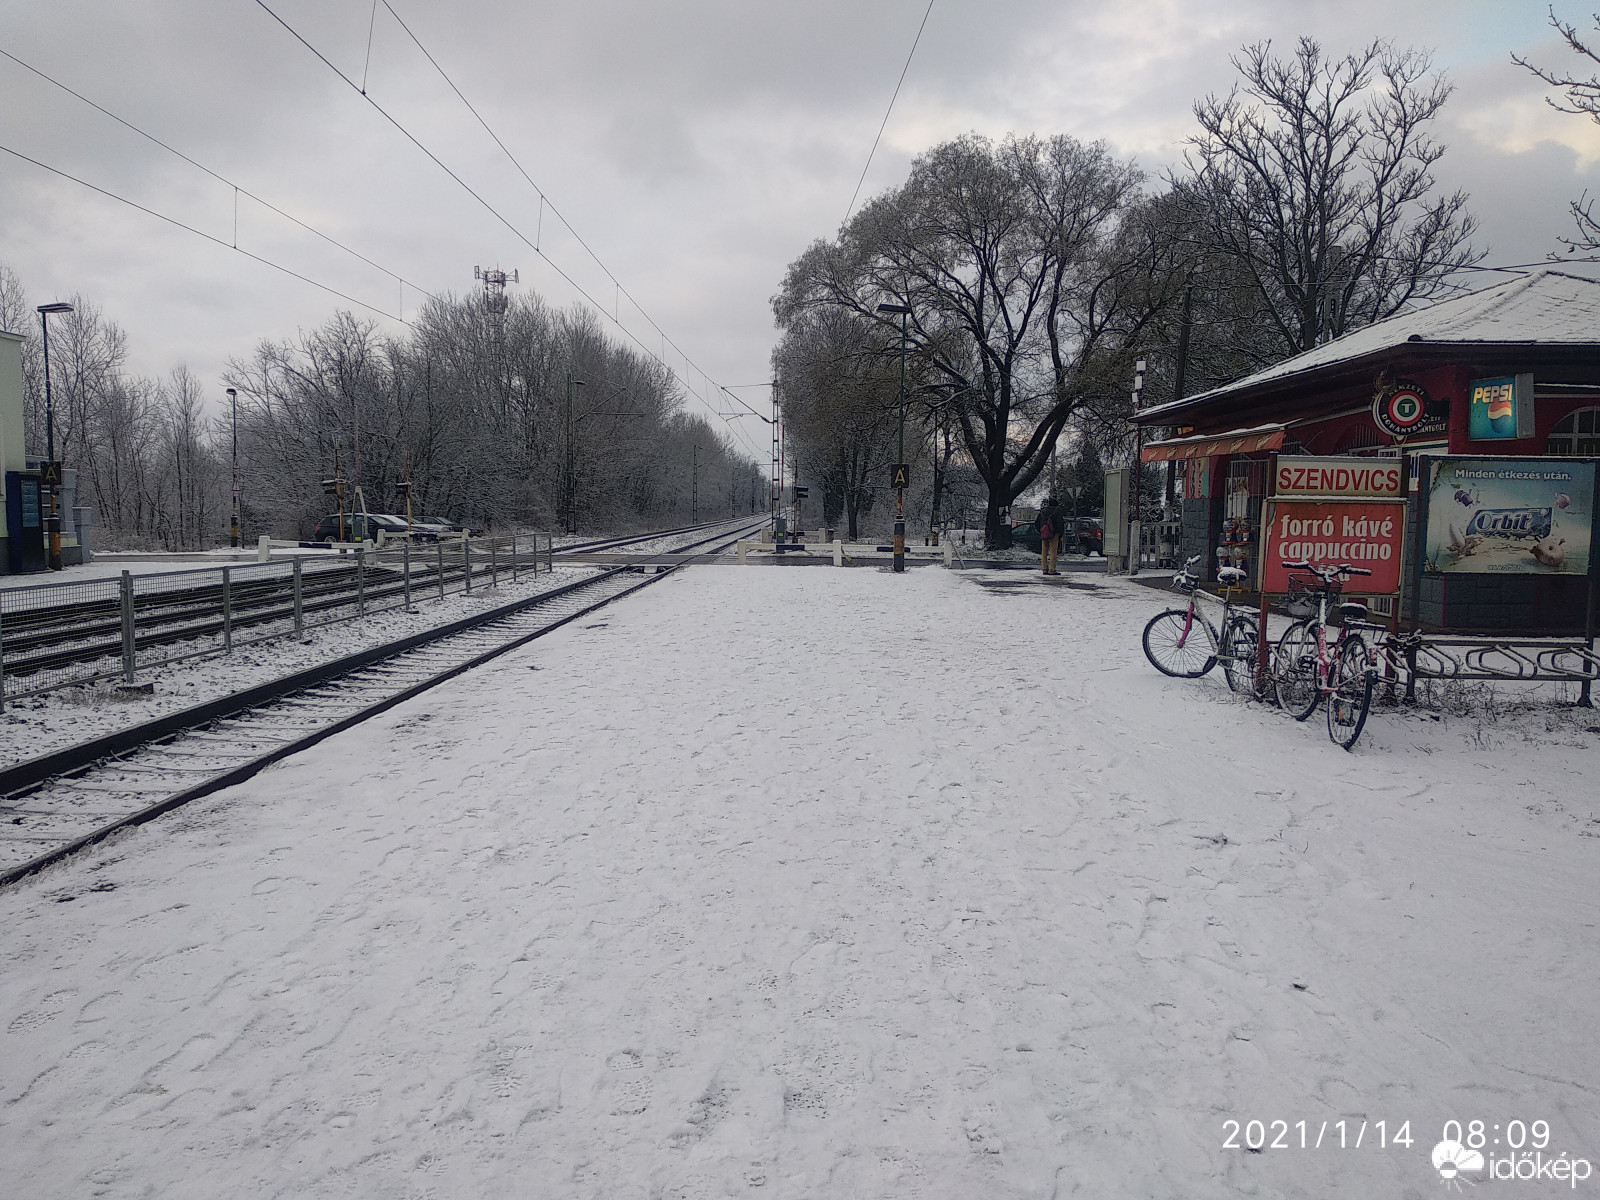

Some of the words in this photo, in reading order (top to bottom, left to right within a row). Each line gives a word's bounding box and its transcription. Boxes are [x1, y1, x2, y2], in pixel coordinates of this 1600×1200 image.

[1388, 383, 1425, 397] NEMZETI
[1473, 384, 1513, 404] PEPSI
[1401, 403, 1413, 414] T
[46, 466, 57, 480] A
[895, 469, 905, 483] A
[1278, 467, 1399, 491] SZENDVICS
[1455, 469, 1495, 478] Minden
[1499, 469, 1541, 480] étkezés
[1543, 471, 1572, 481] után.
[1280, 514, 1335, 539] forró
[1342, 515, 1393, 538] kávé
[1476, 512, 1532, 531] Orbit
[1278, 538, 1392, 561] cappuccino
